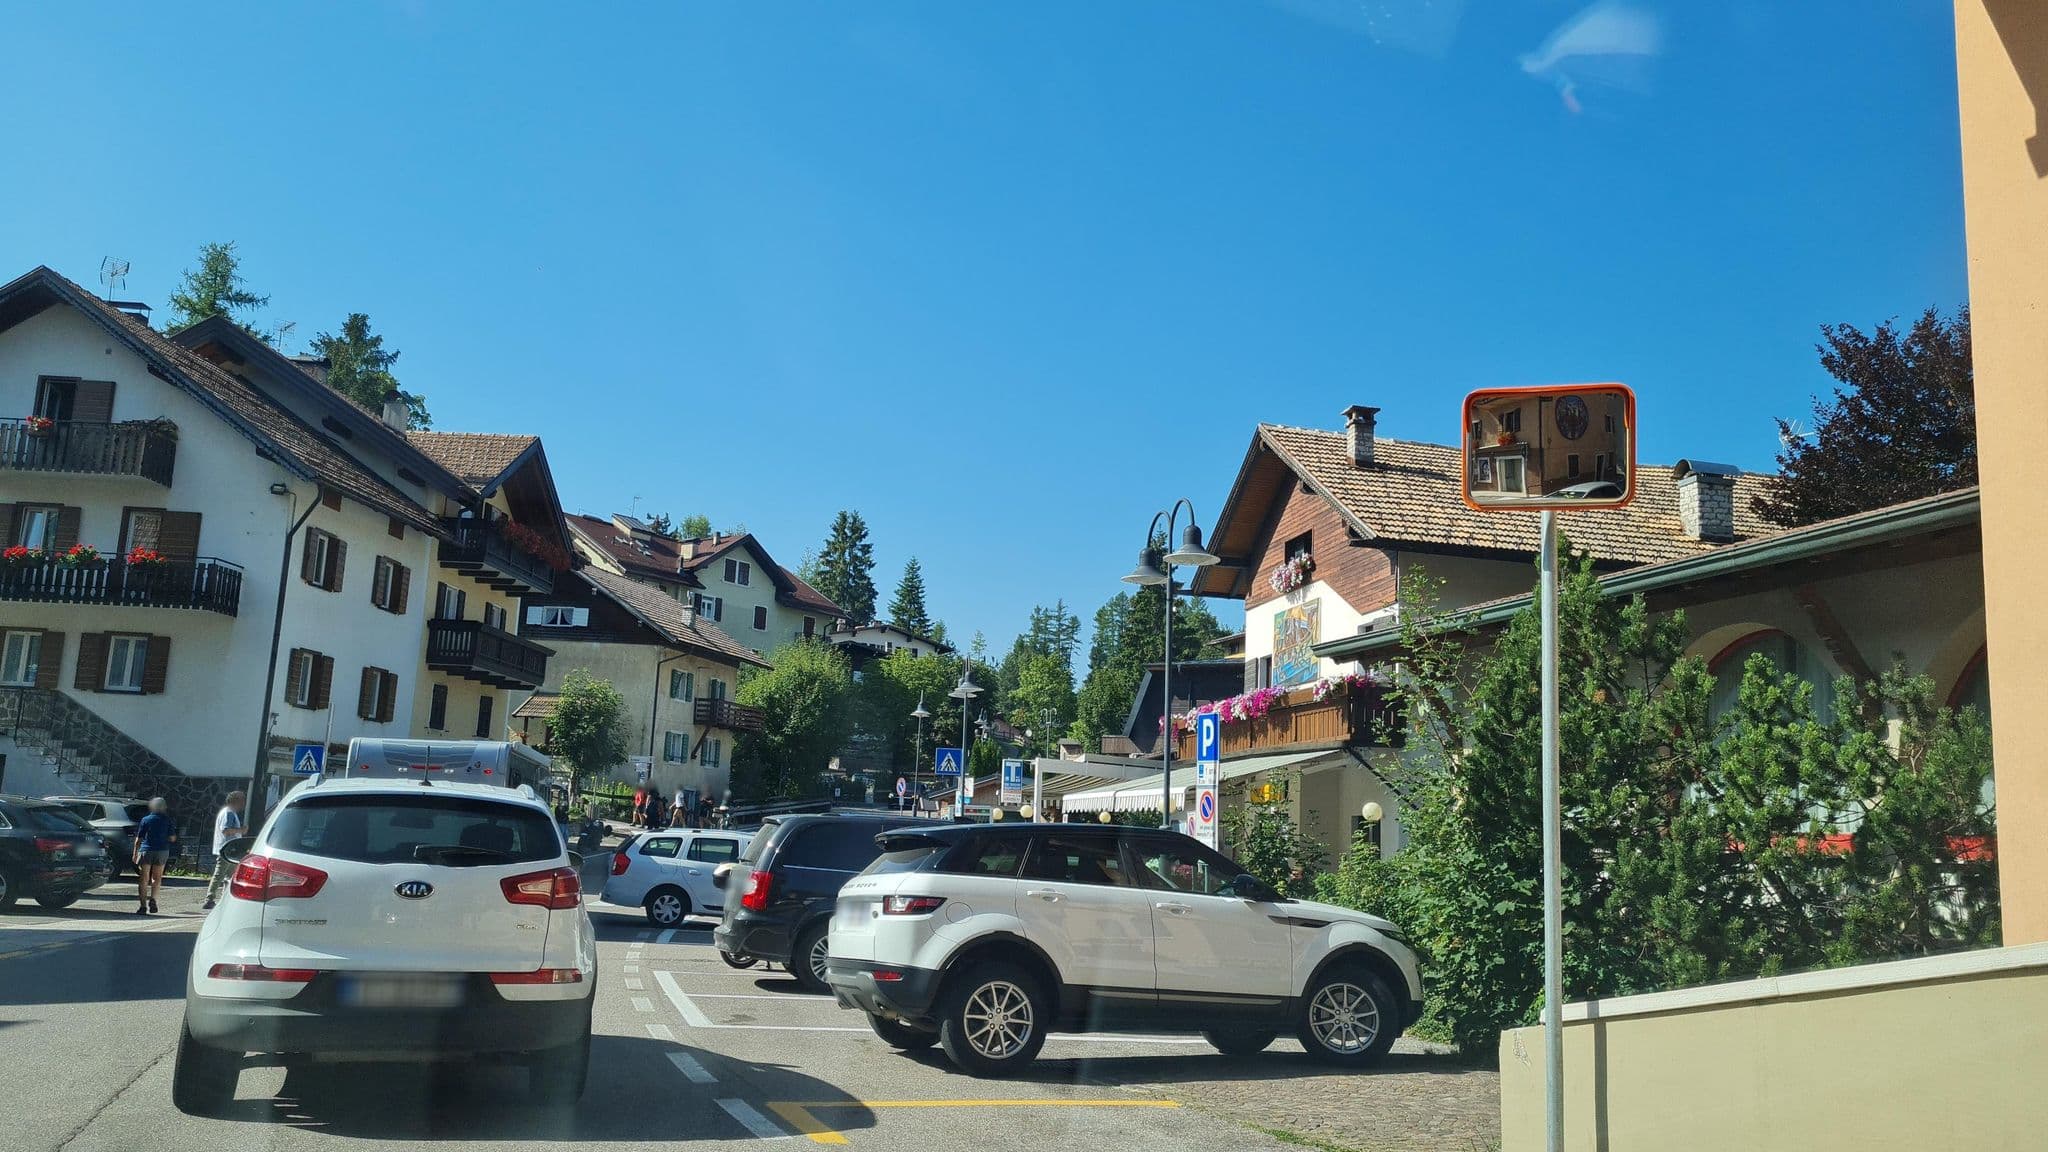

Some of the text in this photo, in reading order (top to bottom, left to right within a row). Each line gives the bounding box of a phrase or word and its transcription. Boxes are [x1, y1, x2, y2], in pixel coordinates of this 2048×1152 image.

[1202, 718, 1214, 757] P
[1005, 761, 1021, 783] T
[401, 882, 428, 896] KIA
